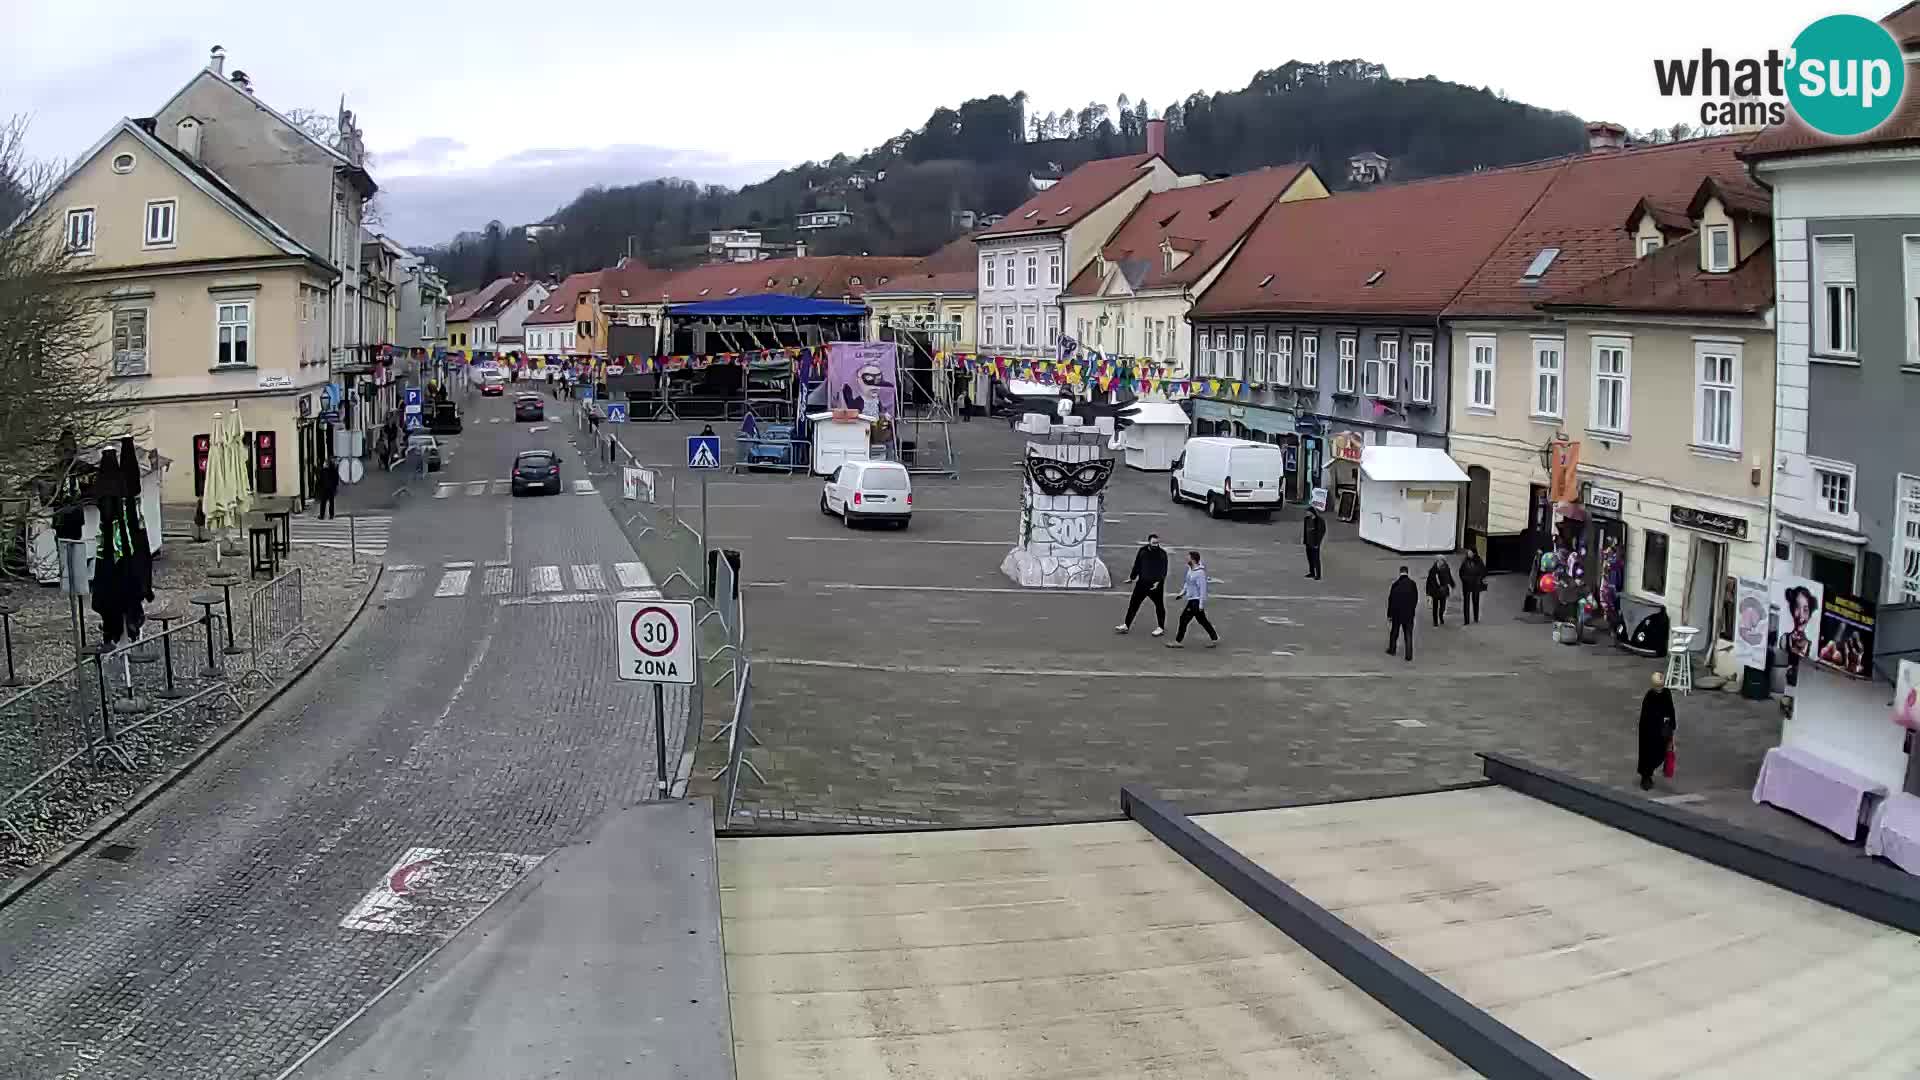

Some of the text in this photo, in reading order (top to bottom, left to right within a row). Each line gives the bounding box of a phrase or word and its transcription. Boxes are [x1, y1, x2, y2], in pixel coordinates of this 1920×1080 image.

[409, 391, 417, 403] P
[643, 622, 667, 643] 30
[634, 659, 678, 676] ZONA
